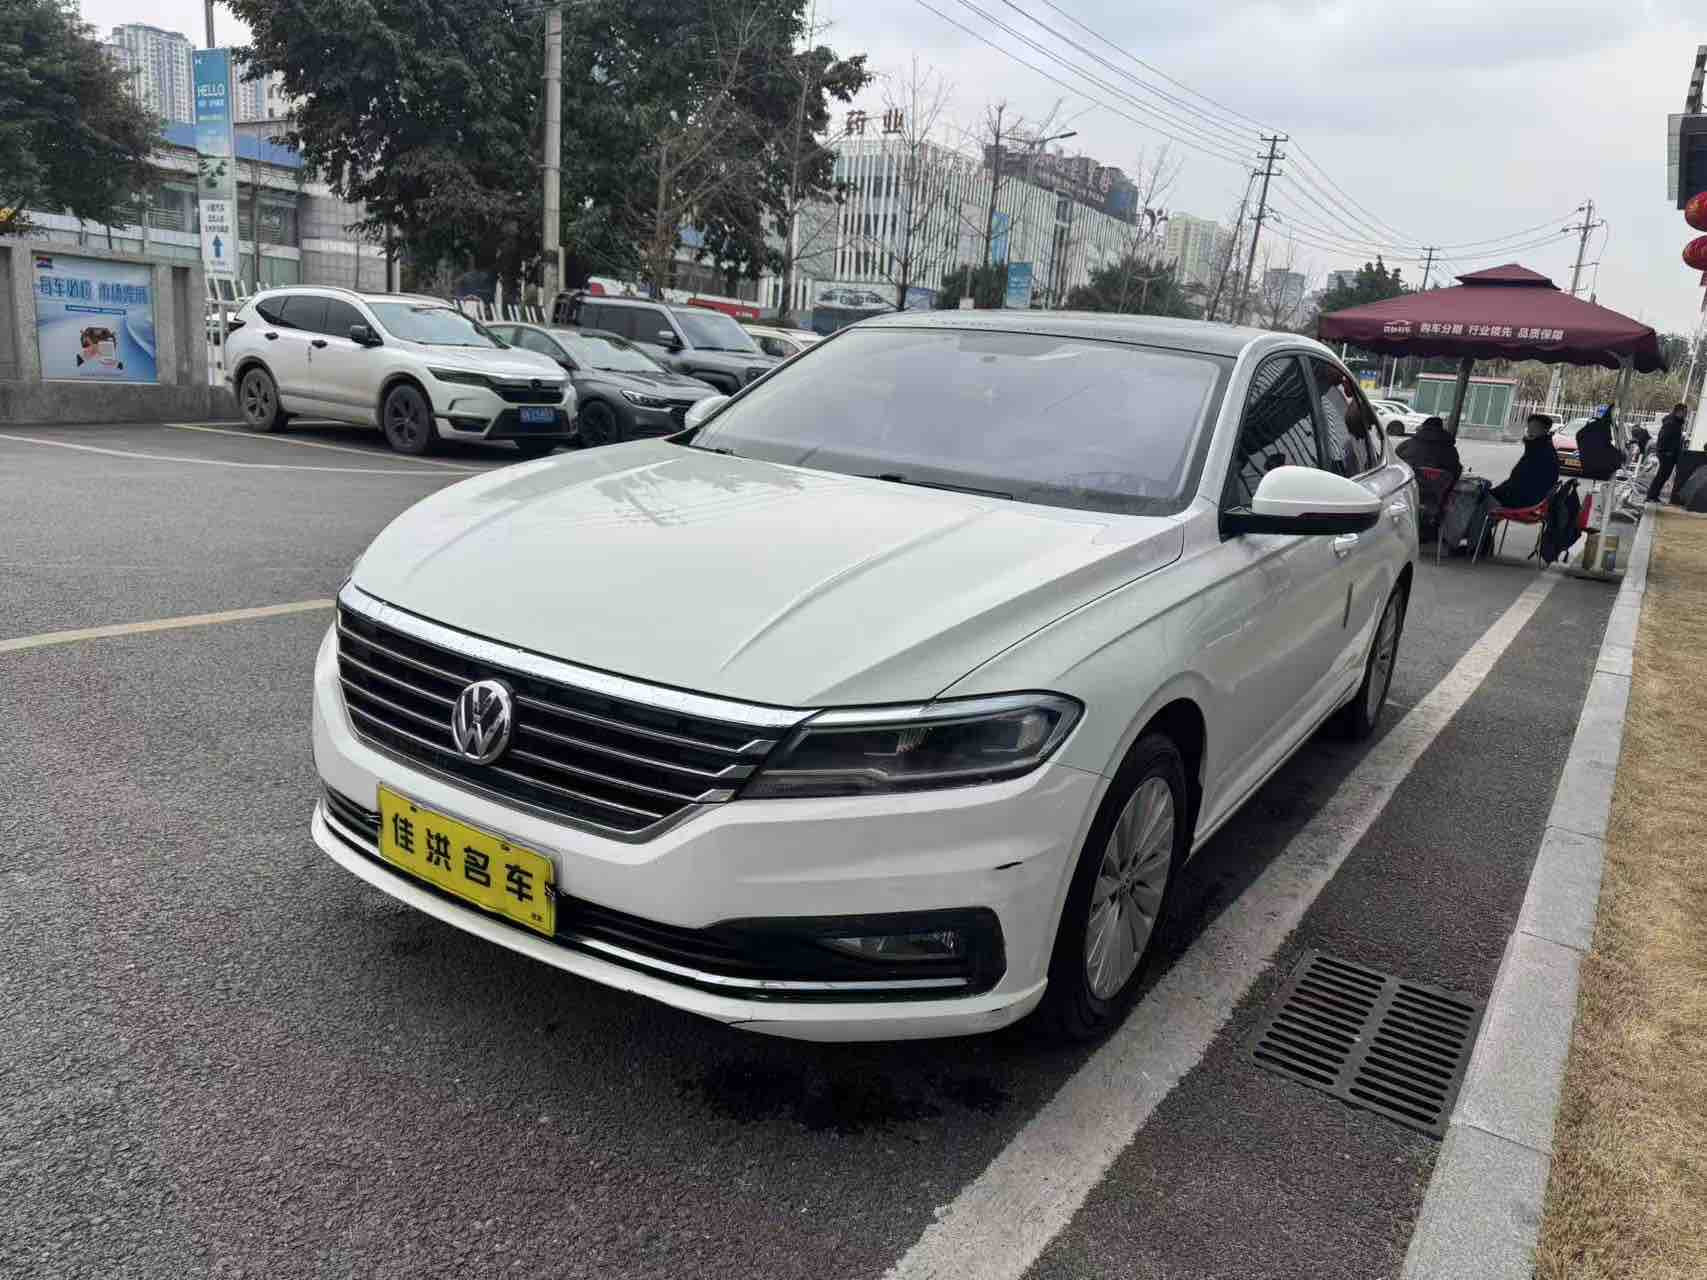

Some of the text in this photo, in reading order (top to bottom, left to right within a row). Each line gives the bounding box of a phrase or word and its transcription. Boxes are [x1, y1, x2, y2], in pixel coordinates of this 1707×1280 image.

[197, 82, 225, 97] HELLO
[846, 109, 904, 135] 药业
[391, 812, 534, 903] 佳洪名车
